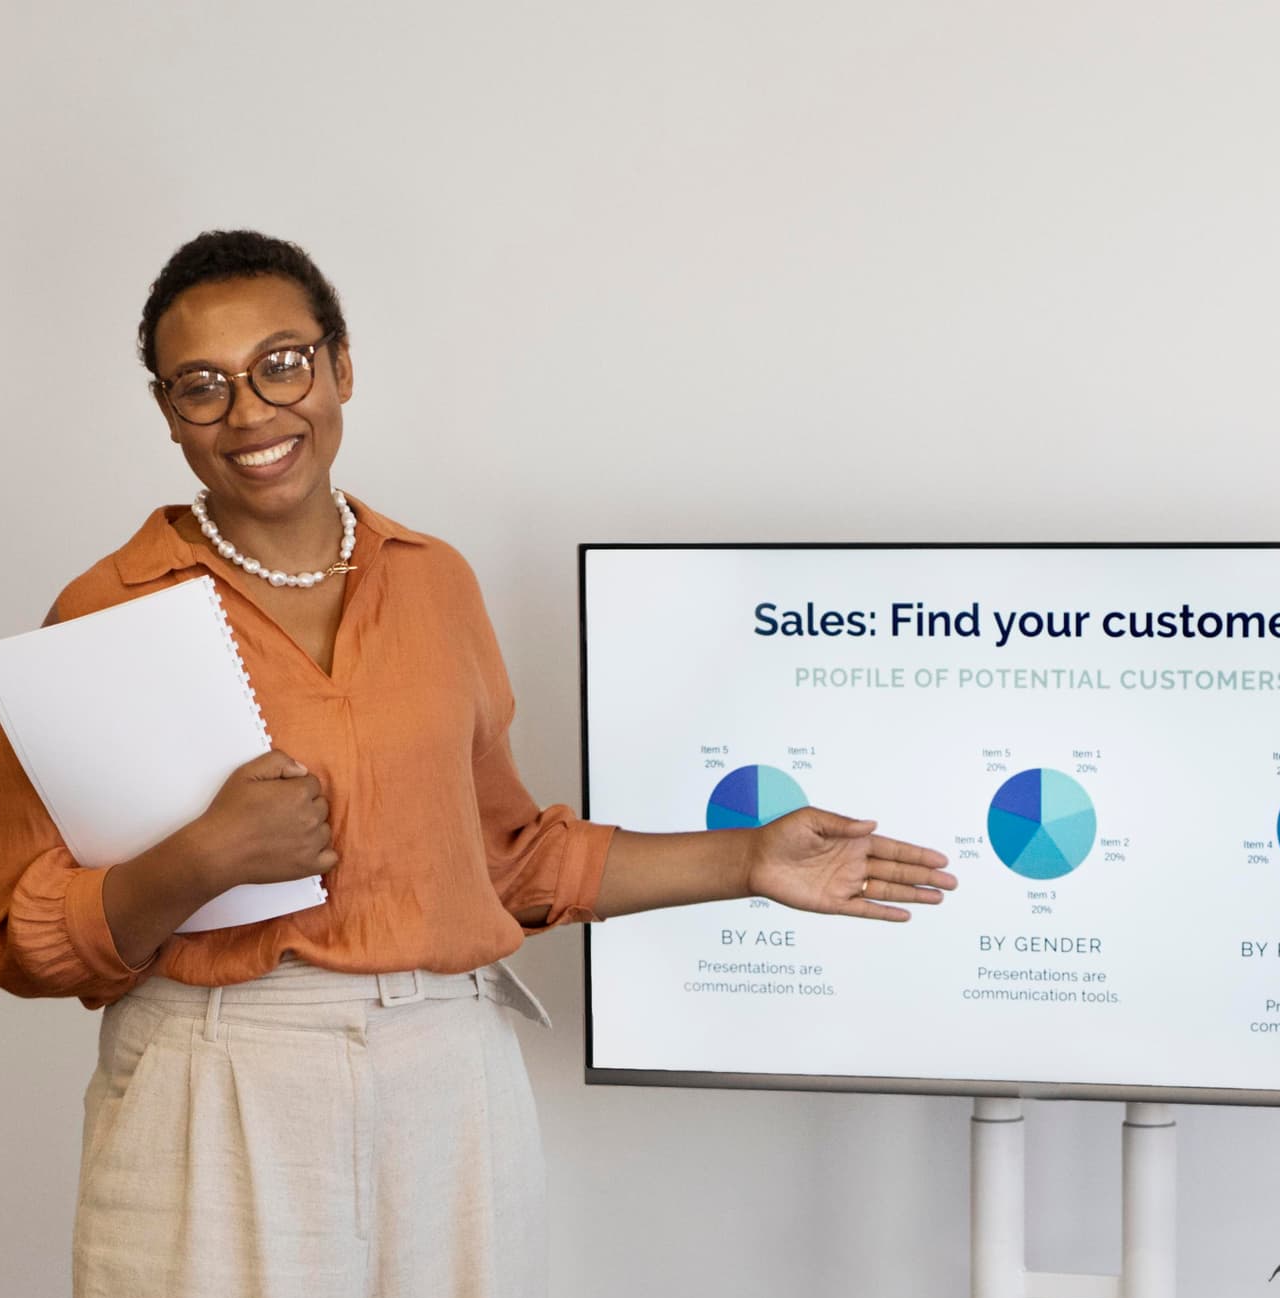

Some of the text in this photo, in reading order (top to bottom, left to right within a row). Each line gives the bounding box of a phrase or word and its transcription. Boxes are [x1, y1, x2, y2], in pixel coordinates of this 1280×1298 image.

[754, 601, 876, 637] Sales:
[892, 602, 980, 637] Find
[994, 612, 1090, 647] your
[796, 667, 904, 688] PROFILE
[914, 668, 949, 688] OF
[959, 669, 1110, 689] POTENTIAL
[701, 745, 728, 754] Item 5
[788, 746, 816, 755] Item 1
[982, 749, 1011, 757] Item 5
[1072, 749, 1101, 758] Item 1
[704, 760, 725, 768] 20%
[792, 761, 812, 769] 20%
[986, 763, 1007, 772] 20%
[1076, 764, 1097, 773] 20%
[954, 836, 983, 844] Item 4
[1100, 838, 1129, 847] Item 2
[1243, 840, 1273, 849] Item 4
[959, 850, 980, 859] 20%
[1104, 853, 1126, 861] 20%
[1247, 855, 1269, 864] 20%
[1027, 891, 1056, 900] Item 3
[1031, 905, 1052, 914] 20%
[721, 930, 796, 946] BY AGE
[979, 935, 1102, 953] BY GENDER
[1241, 941, 1268, 957] BY
[698, 960, 823, 975] Presentations are
[977, 967, 1107, 982] Presentations are
[683, 980, 794, 994] communication
[963, 988, 1077, 1002] communication
